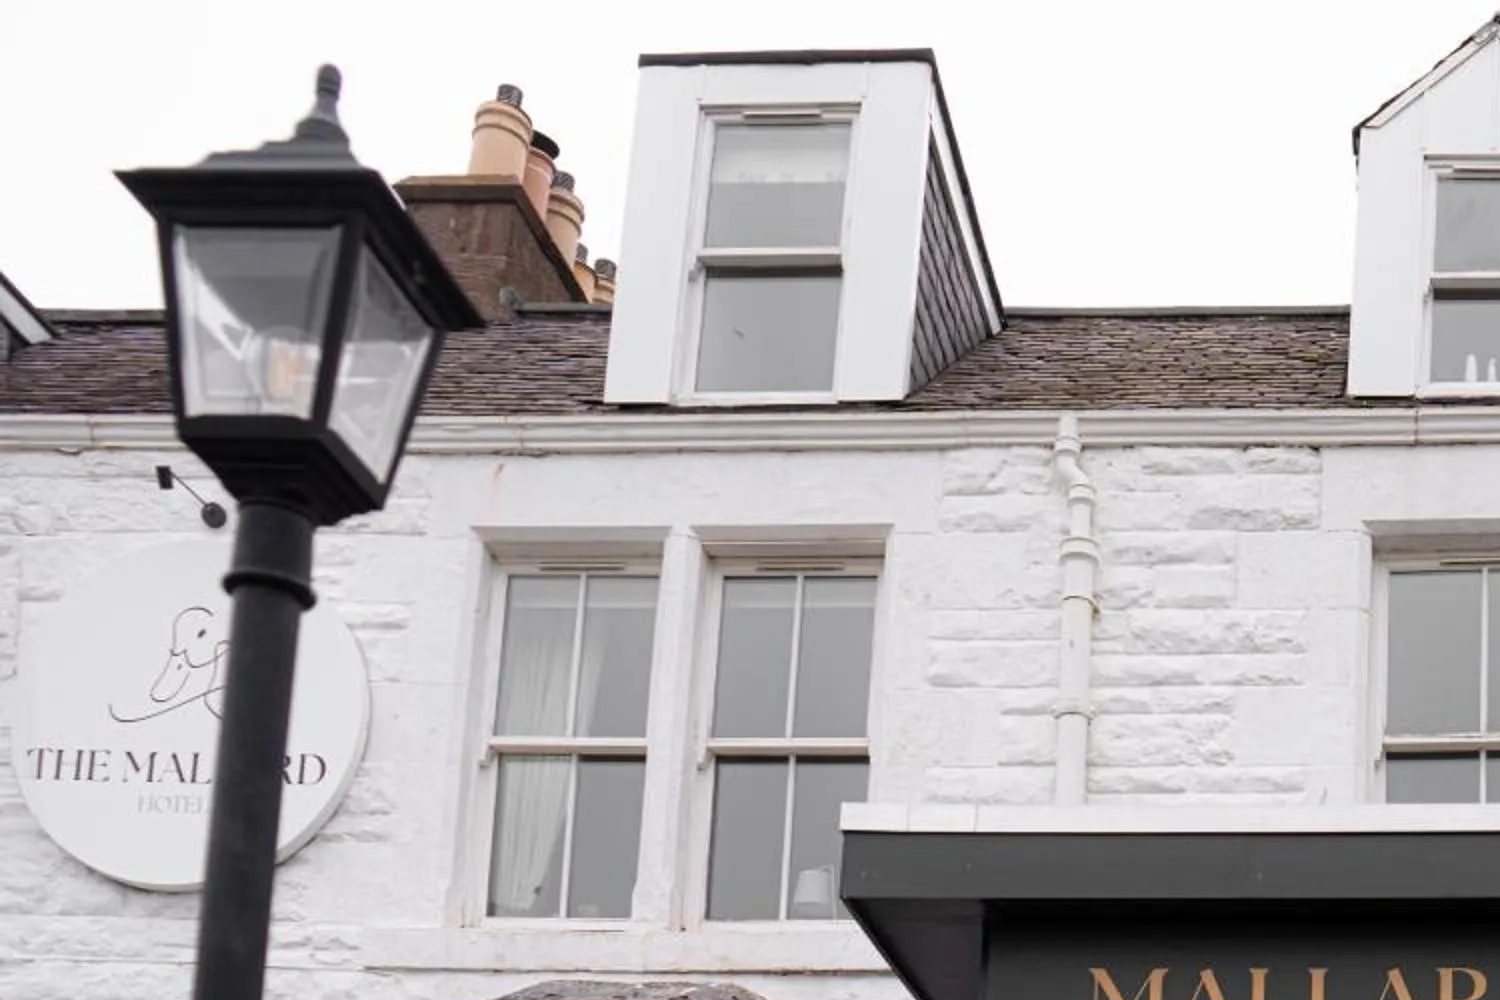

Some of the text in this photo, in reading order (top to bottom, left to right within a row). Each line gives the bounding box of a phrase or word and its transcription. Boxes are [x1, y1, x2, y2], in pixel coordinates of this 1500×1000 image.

[26, 747, 327, 785] THE MALRD
[137, 794, 210, 815] HOTEL
